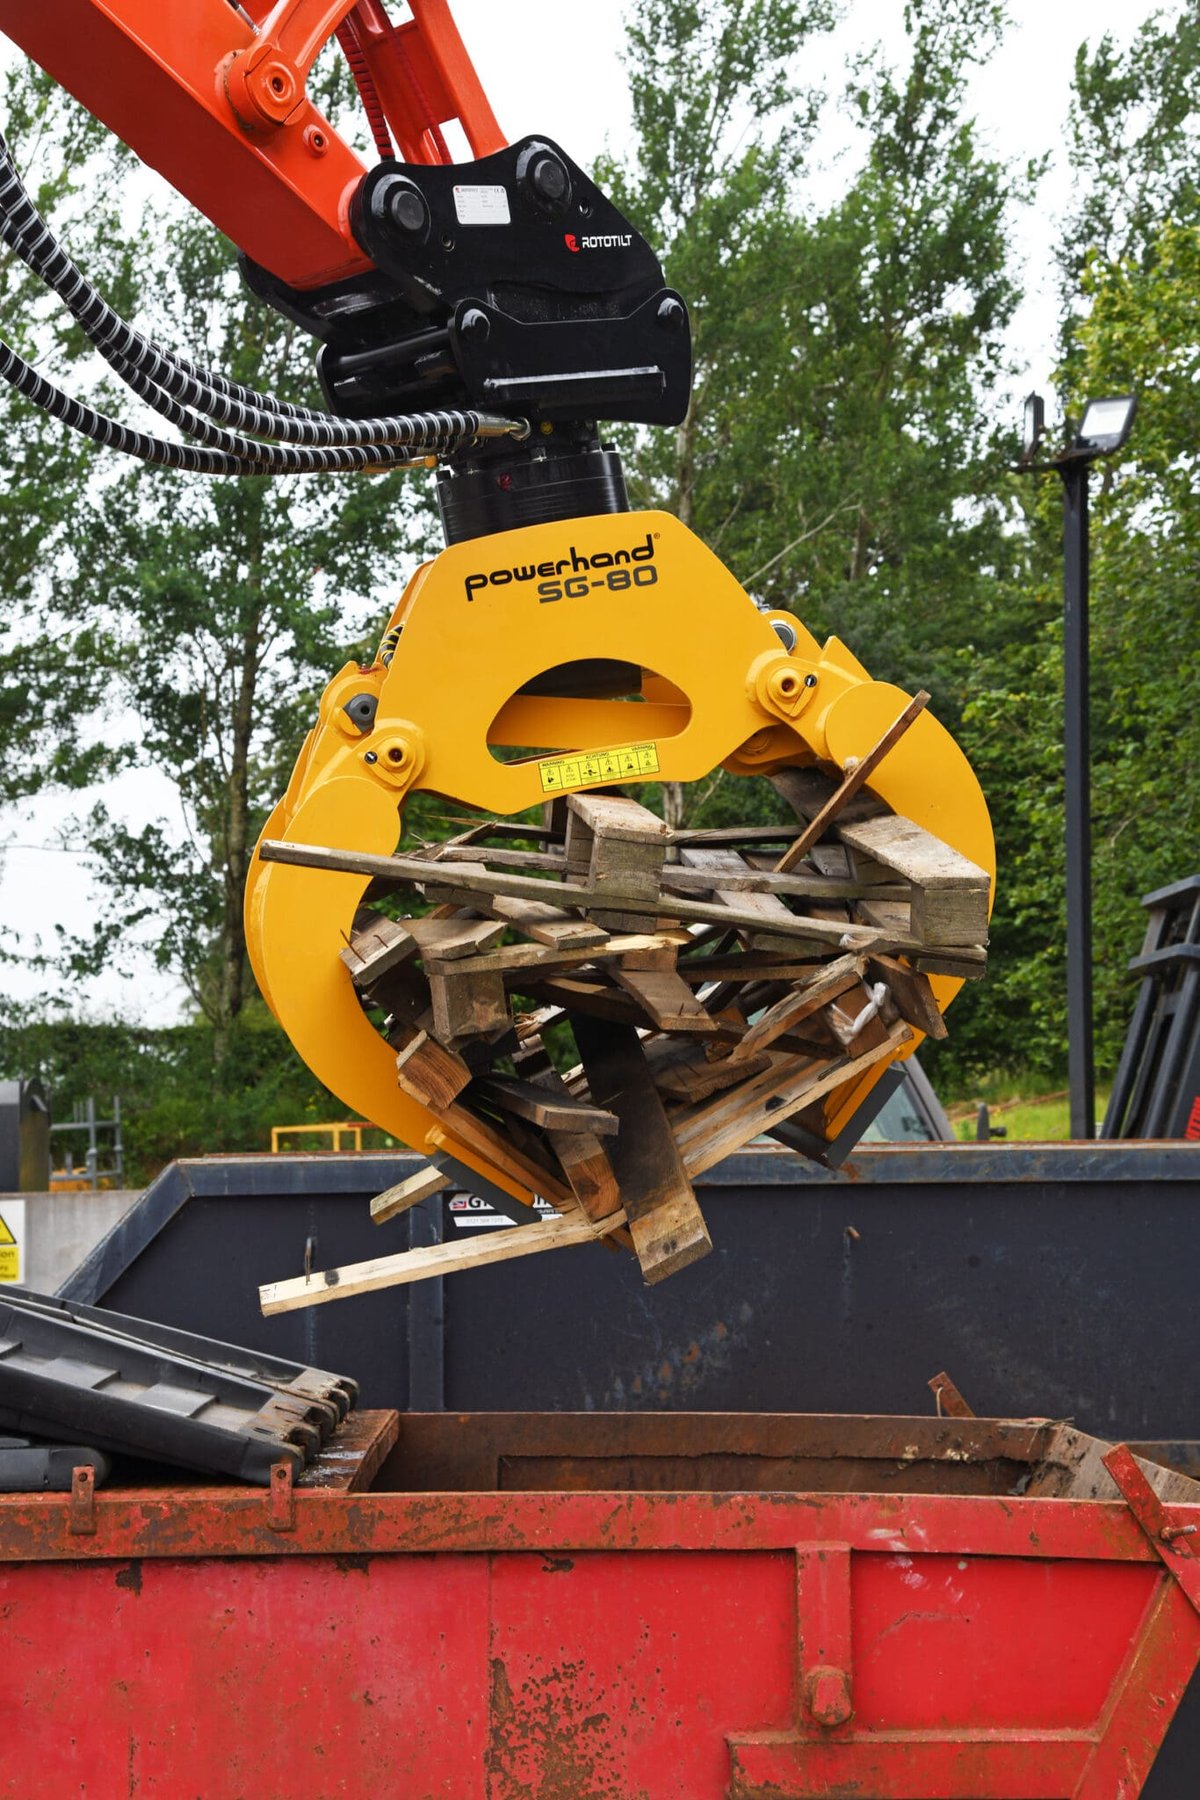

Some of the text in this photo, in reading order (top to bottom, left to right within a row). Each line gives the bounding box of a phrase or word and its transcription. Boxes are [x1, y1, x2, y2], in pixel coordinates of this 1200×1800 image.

[582, 235, 632, 248] ROTOTILT
[465, 534, 655, 602] powerhand
[537, 565, 658, 604] SG-80
